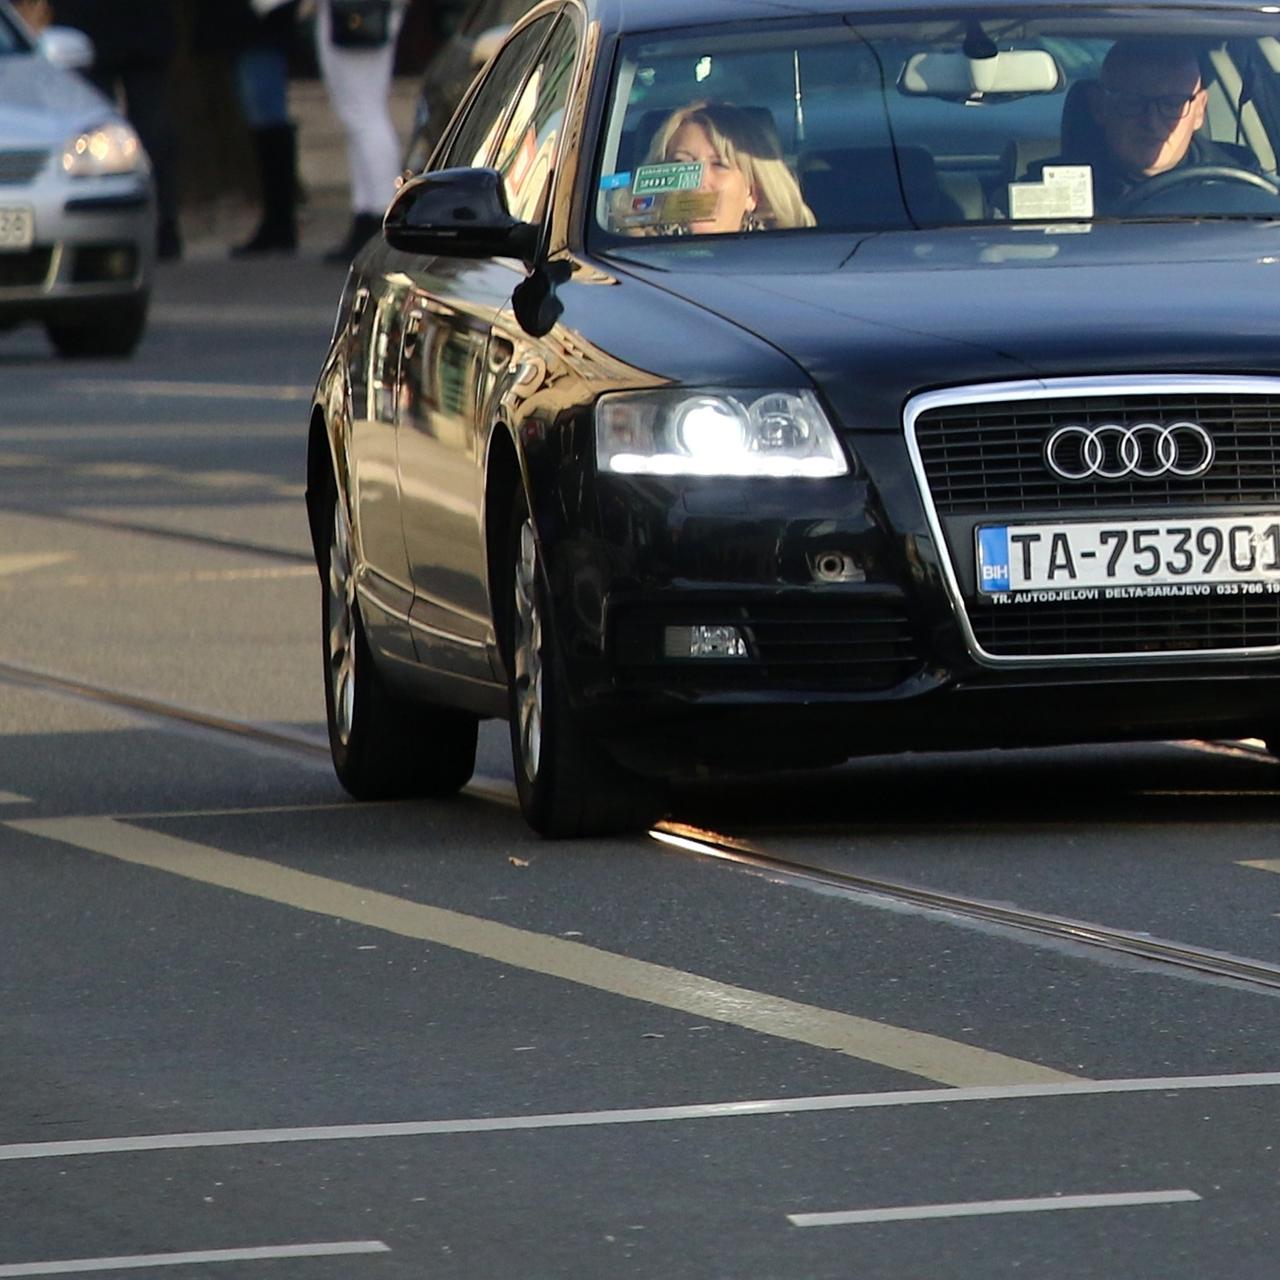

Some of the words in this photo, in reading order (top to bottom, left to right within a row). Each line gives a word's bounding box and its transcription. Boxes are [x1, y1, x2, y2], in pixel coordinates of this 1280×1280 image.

[983, 566, 1007, 579] BIH
[992, 593, 1012, 605] TR.
[1014, 589, 1099, 604] AUTODJELOVI
[1105, 584, 1211, 599] DELTA-SARAJEVO
[1216, 583, 1239, 595] 033
